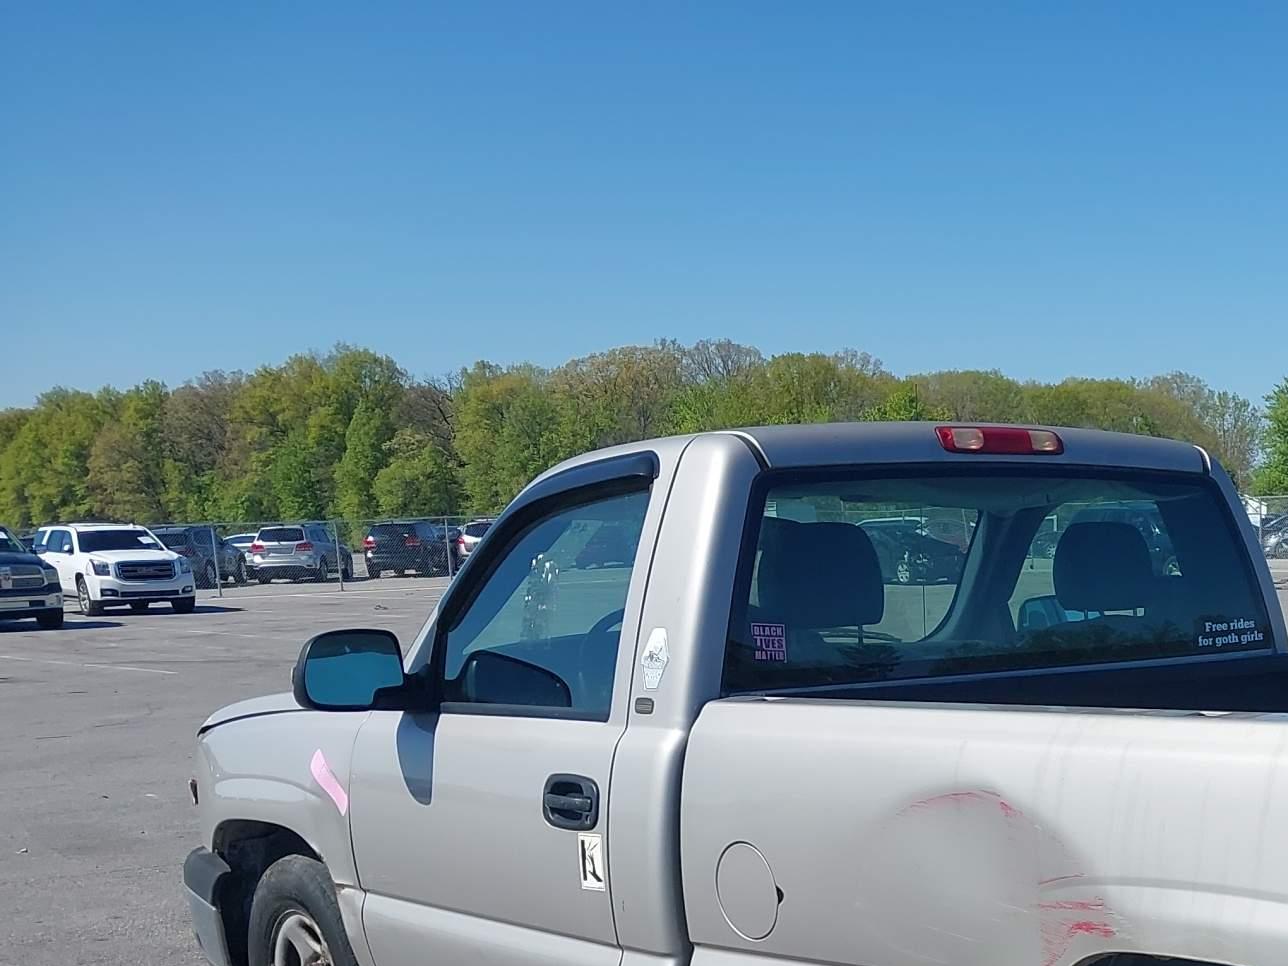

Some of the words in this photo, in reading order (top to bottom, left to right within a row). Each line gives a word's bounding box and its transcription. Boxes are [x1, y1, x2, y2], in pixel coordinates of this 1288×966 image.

[754, 626, 782, 636] BLACK
[1205, 622, 1228, 634] Free
[1230, 618, 1255, 630] rides
[1198, 635, 1213, 647] for
[1215, 632, 1239, 647] goth
[1241, 630, 1264, 645] girls
[755, 651, 784, 660] MATTER
